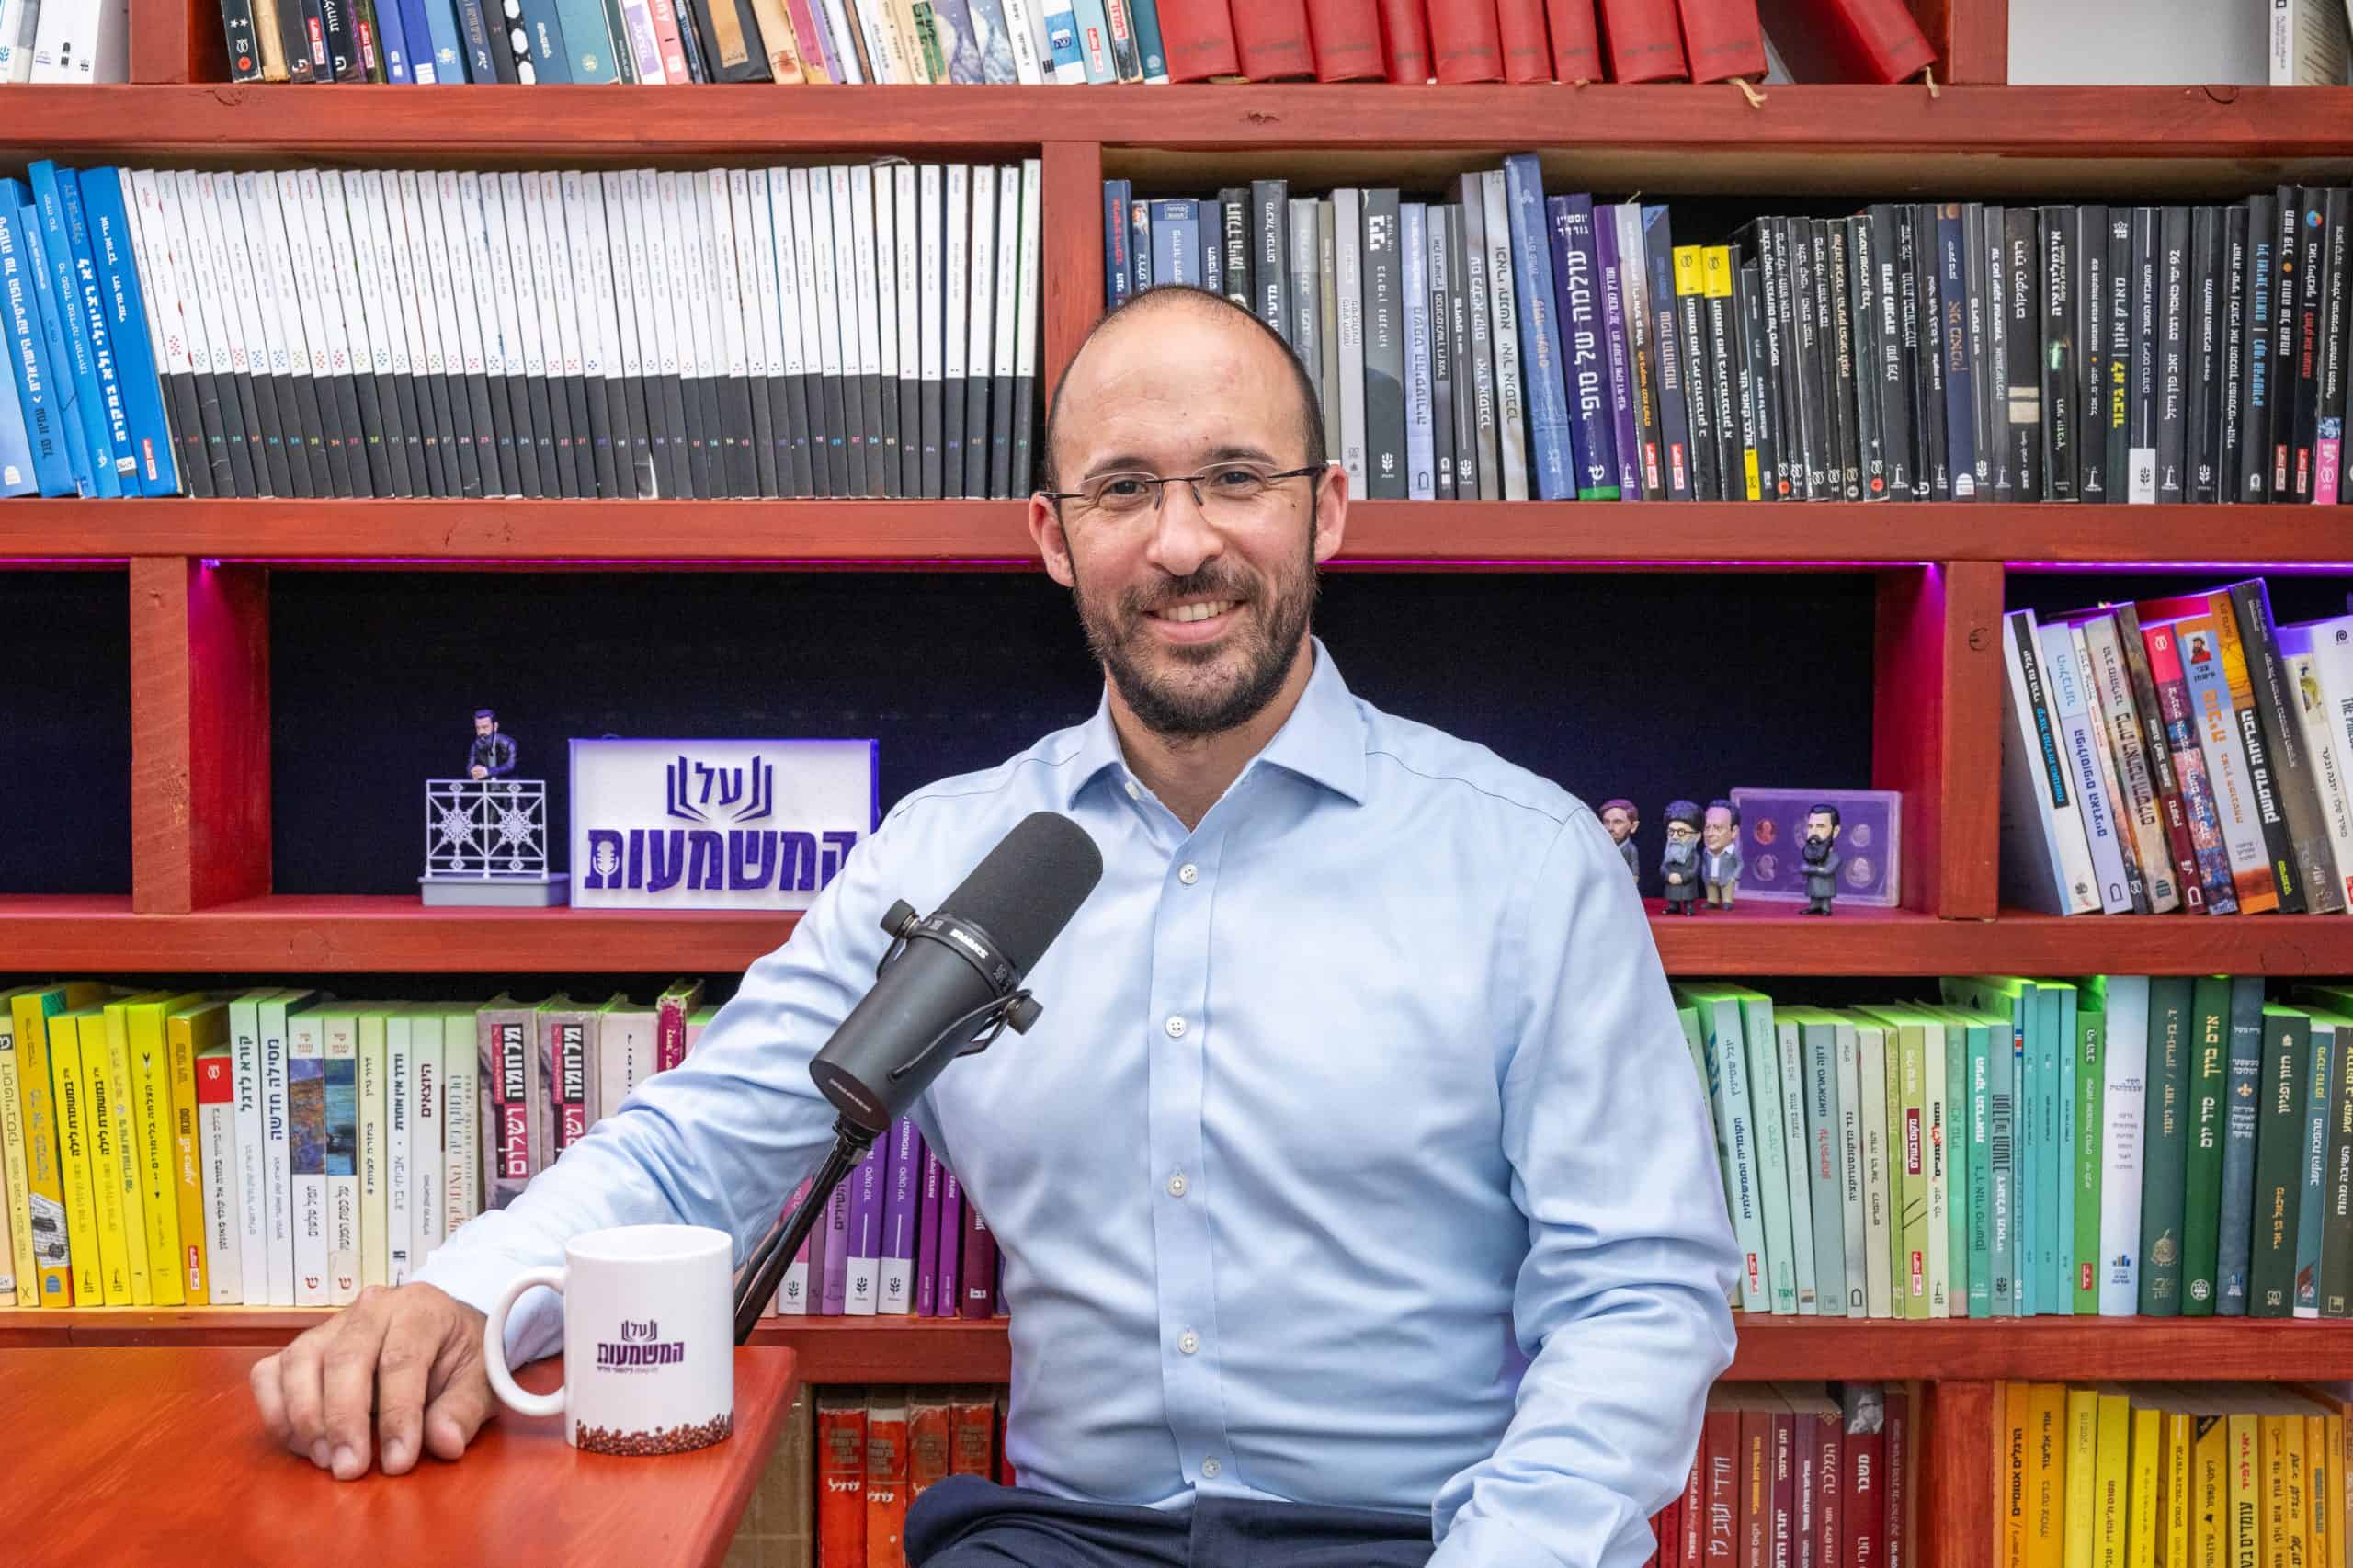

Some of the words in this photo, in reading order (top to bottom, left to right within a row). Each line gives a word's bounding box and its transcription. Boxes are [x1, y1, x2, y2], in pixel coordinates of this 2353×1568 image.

[1369, 215, 1385, 251] ביבי
[2284, 210, 2295, 233] משה
[1266, 233, 1275, 262] אברהם
[1470, 257, 1482, 274] עם
[2169, 250, 2181, 265] 92
[76, 258, 92, 279] לא
[1377, 265, 1388, 302] בנימין
[1566, 250, 1591, 323] עולמה
[1498, 288, 1512, 330] יתנשא
[2112, 277, 2128, 317] מארק
[2282, 279, 2293, 305] מותה
[4, 257, 16, 274] של
[19, 338, 41, 391] הישראלית
[81, 285, 104, 345] רציונלי
[1378, 309, 1388, 347] נתניהו
[1414, 306, 1425, 346] משפט
[1472, 314, 1485, 341] יקום
[1659, 312, 1672, 337] שפת
[1947, 301, 1961, 324] אני
[2281, 309, 2291, 324] של
[99, 351, 115, 380] ולא
[1503, 342, 1514, 368] יאיר
[1574, 331, 1596, 365] של
[1662, 340, 1677, 390] התהומות
[1949, 327, 1971, 371] מאמין
[1477, 358, 1488, 382] יאיר
[1692, 359, 1701, 378] בית
[1717, 360, 1727, 380] בית
[2110, 361, 2125, 383] לא
[1415, 352, 1427, 425] ההיסטוריה
[1576, 372, 1601, 420] סופי
[105, 386, 127, 442] במקרה
[2112, 387, 2125, 427] גיבור
[2023, 650, 2033, 668] יובל
[2102, 646, 2114, 665] הרב
[2026, 671, 2035, 684] נח
[2055, 654, 2075, 706] היילברונר
[2036, 707, 2049, 733] קיצור
[2046, 766, 2065, 802] האנושות
[2239, 710, 2264, 764] הבריחה
[694, 760, 743, 805] על
[2073, 728, 2095, 788] הפילוסופים
[2087, 793, 2108, 837] הארציים
[2115, 712, 2135, 740] ברית
[2127, 781, 2154, 826] והשלום
[2251, 767, 2280, 824] מדמשק
[584, 827, 857, 895] המשמעות
[2206, 1015, 2219, 1043] אדם
[237, 1035, 252, 1072] קורא
[267, 1039, 280, 1088] מסילה
[364, 1057, 373, 1075] דרור
[393, 1053, 404, 1078] ודרך
[503, 1027, 524, 1097] מלחמה
[562, 1028, 582, 1097] מלחמה
[2204, 1047, 2219, 1077] ברוך
[2279, 1054, 2292, 1080] חזון
[2315, 1046, 2326, 1065] מיכה
[394, 1081, 405, 1096] אין
[420, 1063, 432, 1119] היוצאים
[1975, 1057, 1986, 1093] העיקר
[64, 1081, 79, 1128] במשמרת
[94, 1081, 108, 1127] במשמרת
[144, 1085, 155, 1119] הצלחה
[240, 1075, 254, 1112] לדגל
[1992, 1094, 2011, 1123] הקרב
[2201, 1096, 2215, 1122] סדר
[268, 1094, 283, 1141] חדשה
[394, 1098, 404, 1131] אחרת
[1845, 1111, 1854, 1127] נגד
[1909, 1118, 1919, 1140] מקום
[1975, 1096, 1985, 1143] הבריאות
[69, 1131, 81, 1157] לילה
[97, 1130, 111, 1156] לילה
[147, 1122, 159, 1169] בלימודים
[497, 1108, 527, 1175] ושלום
[900, 1121, 911, 1160] המשפחה
[1733, 1117, 1746, 1160] הקומדיה
[2200, 1127, 2214, 1148] יום
[2312, 1118, 2323, 1153] מהפכת
[394, 1155, 404, 1188] אביחי
[1846, 1130, 1858, 1201] הדקונסטרוקציה
[1909, 1142, 1919, 1169] בעולם
[1992, 1136, 2011, 1173] המערב
[2337, 1145, 2351, 1181] השיבה
[335, 1186, 349, 1198] על
[394, 1191, 404, 1211] ברג
[1737, 1162, 1752, 1220] הממשלתית
[1996, 1176, 2006, 1215] דאגלס
[2336, 1184, 2348, 1216] מהודו
[1975, 1211, 1986, 1251] פרישמן
[1995, 1217, 2006, 1253] מאריי
[629, 1322, 648, 1337] על
[597, 1342, 685, 1366] המשמעות
[2042, 1411, 2051, 1432] אורי
[2012, 1428, 2023, 1469] הרגלים
[2042, 1435, 2051, 1470] אליצור
[2242, 1432, 2251, 1458] יאיר
[1712, 1456, 1732, 1496] חרדי
[1820, 1443, 1836, 1494] המלכה
[1857, 1454, 1870, 1493] משבר
[2241, 1462, 2251, 1490] לפיד
[2011, 1472, 2022, 1516] אטומיים
[1777, 1509, 1789, 1539] יתרון
[2239, 1502, 2254, 1547] עומדים
[1857, 1536, 1870, 1562] הנרי
